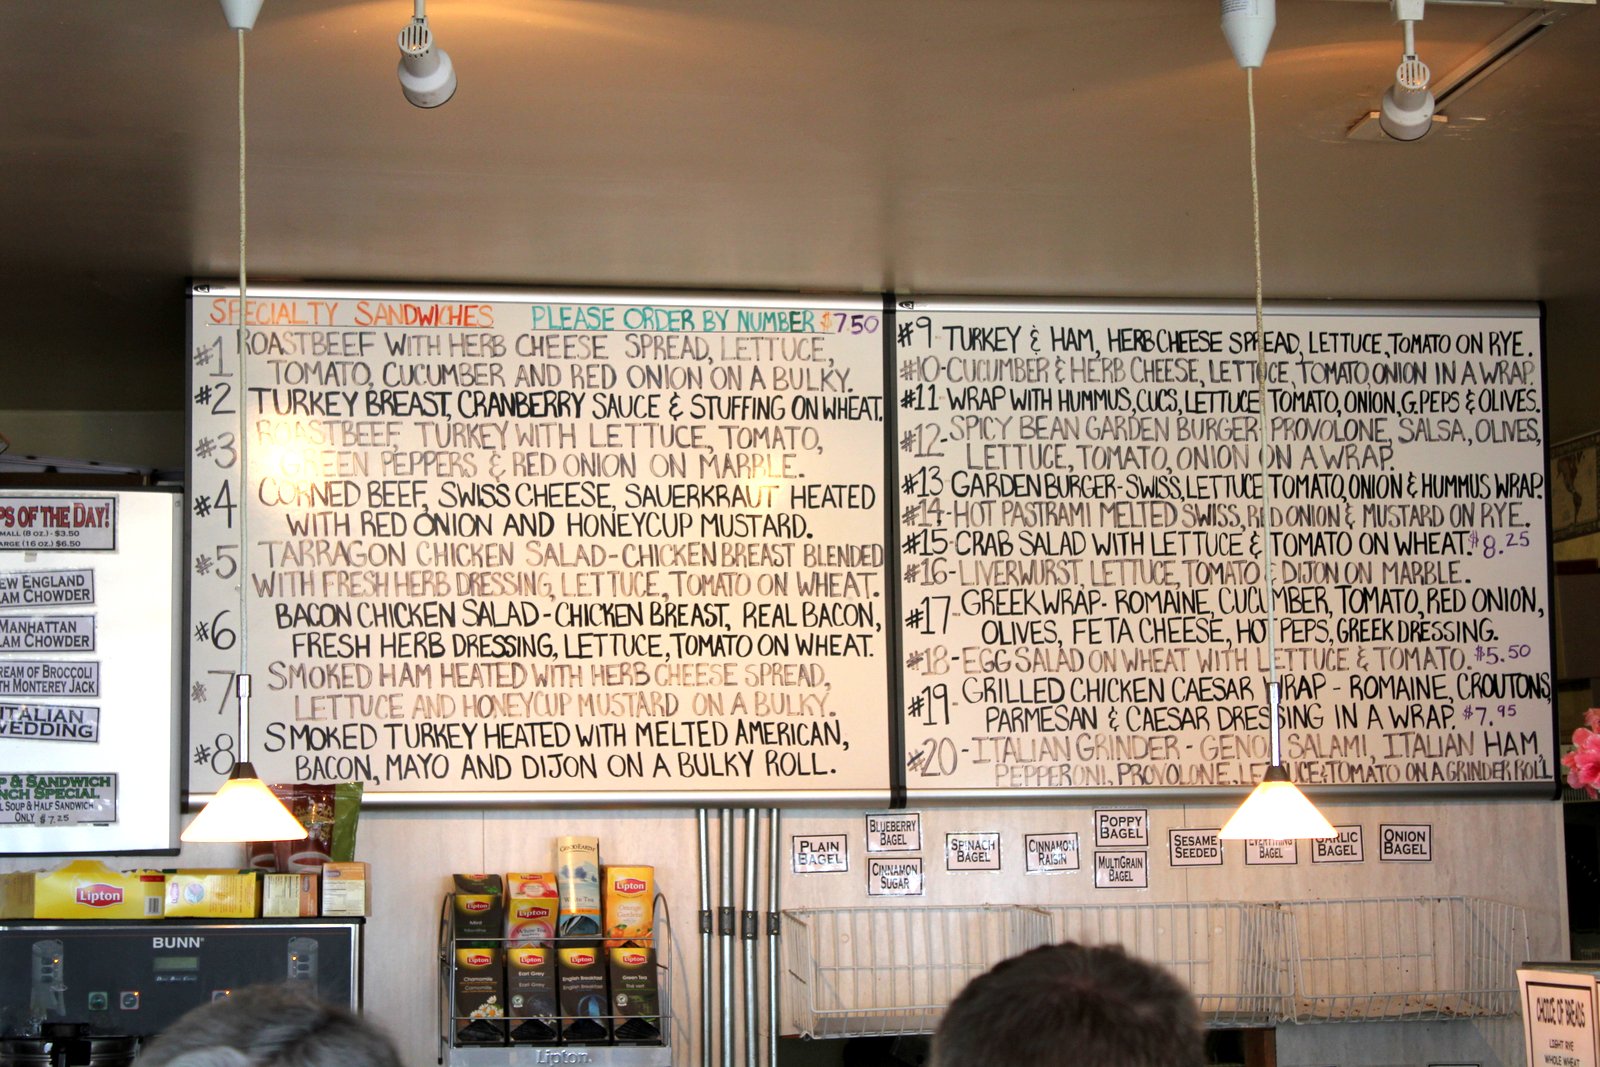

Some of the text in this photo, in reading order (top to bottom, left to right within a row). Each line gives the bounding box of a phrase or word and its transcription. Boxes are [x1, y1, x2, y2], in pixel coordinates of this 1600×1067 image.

[210, 297, 338, 325] SPECIALTY
[353, 300, 494, 328] SANDWICHES
[531, 305, 615, 331] PLEASE
[623, 305, 695, 333] ORDER
[703, 309, 729, 333] BY
[737, 310, 815, 334] NUMBER
[897, 316, 932, 349] #9
[942, 325, 1022, 353] TURKEY
[1029, 325, 1040, 356] &
[1050, 326, 1101, 358] HAM,
[1107, 327, 1155, 352] HERB
[1156, 328, 1223, 354] CHEESE
[1455, 331, 1484, 355] ON
[1489, 331, 1533, 358] RYE.
[194, 382, 883, 422] #2 TURKEY BREAST, CRANBERRY SAUCE & STUFFING ON WHEAT.
[17, 505, 38, 528] OF
[40, 505, 70, 529] THE
[54, 530, 80, 538] $3.50
[22, 540, 36, 548] (16
[55, 540, 81, 548] $6.50
[954, 529, 1014, 557] CRAB
[1019, 530, 1086, 557] SALAD
[1092, 531, 1144, 557] WITH
[1150, 531, 1244, 557] LETTUCE
[1249, 531, 1263, 559] &
[1269, 531, 1352, 557] TOMATO
[1359, 531, 1390, 557] ON
[1393, 530, 1473, 557] WHEAT.
[1468, 530, 1531, 559] $8.25
[22, 574, 85, 589] ENGLAND
[0, 588, 90, 604] AM CHOWDER
[0, 619, 77, 634] MANHATTAN
[194, 609, 236, 650] #6
[275, 602, 351, 629] BACON
[357, 601, 455, 629] CHICKEN
[650, 601, 731, 631] BREAST,
[742, 602, 797, 629] REAL
[802, 602, 882, 632] BACON,
[0, 633, 90, 648] AM CHOWDER
[27, 666, 40, 678] OF
[42, 664, 92, 679] BROCCOLI
[13, 678, 67, 693] MONTEREY
[69, 677, 95, 693] JACK
[0, 706, 84, 724] ITALIAN
[985, 703, 1517, 733] PARMESAN & CAESAR DRESSING IN A WRAP. $7.95
[194, 719, 849, 776] #8 SMOKED TURKEY HEATED WITH MELTED AMERICAN,
[295, 750, 837, 785] BACON, MAYO AND DIJON ON A BULKY ROLL.
[10, 775, 23, 788] &
[26, 774, 111, 788] SANDWICH
[5, 801, 26, 811] SOUP
[26, 801, 32, 811] &
[34, 801, 54, 811] HALF
[54, 800, 94, 811] SANDWICH
[15, 812, 35, 822] ONLY
[1100, 815, 1143, 828] POPPY
[870, 819, 916, 833] BLUEBERRY
[880, 832, 907, 846] BAGEL
[1100, 827, 1143, 840] BAGEL
[1174, 834, 1218, 847] SESAME
[1384, 829, 1426, 843] ONION
[800, 840, 839, 853] PLAIN
[951, 839, 995, 851] SPINACH
[1028, 839, 1076, 852] CINNAMON
[1318, 843, 1357, 856] BAGEL
[1384, 842, 1427, 855] BAGEL
[798, 852, 842, 865] BAGEL
[957, 850, 991, 863] BAGEL
[1039, 851, 1067, 866] RAISIN
[1175, 846, 1218, 859] SEEDED
[1259, 846, 1283, 859] BAGEL
[872, 862, 918, 876] CINNAMON
[1108, 868, 1134, 883] BAGEL
[616, 881, 644, 891] Lipton
[880, 875, 909, 890] SUGAR
[80, 890, 121, 903] Lipton
[519, 908, 547, 918] Lipton
[152, 936, 200, 949] BUNN
[536, 1049, 589, 1067] Lipton
